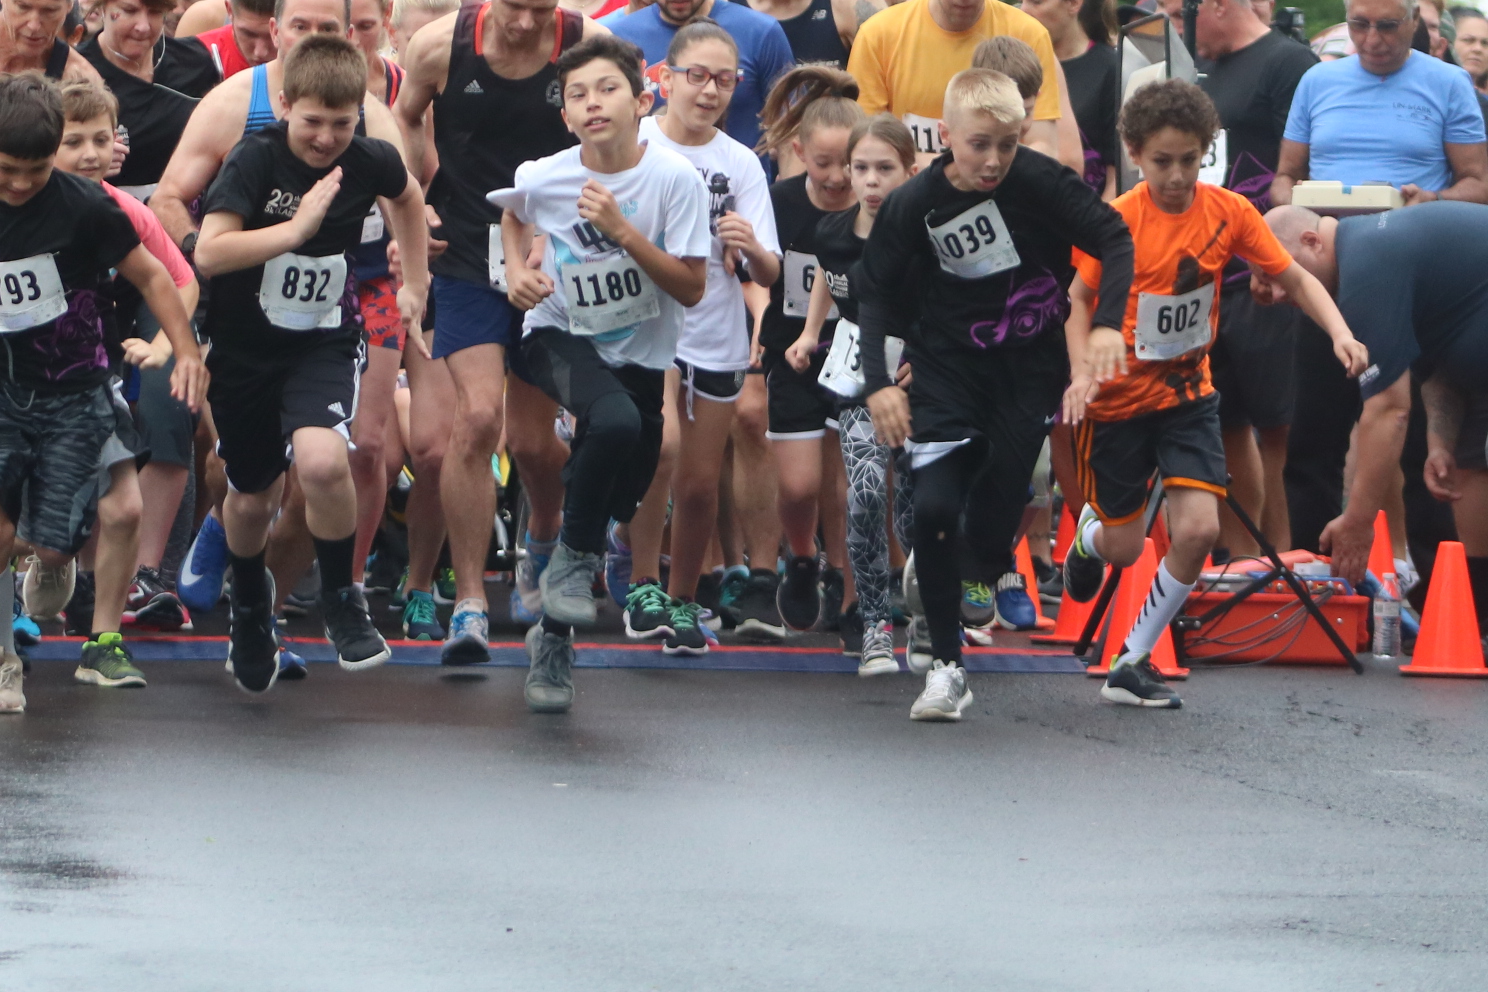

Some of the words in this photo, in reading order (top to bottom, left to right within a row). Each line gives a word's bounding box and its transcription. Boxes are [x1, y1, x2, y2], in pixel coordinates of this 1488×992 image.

[268, 188, 294, 207] 20
[281, 265, 331, 301] 832
[572, 268, 642, 307] 1180
[1157, 298, 1201, 334] 602
[997, 572, 1023, 592] NIKE
